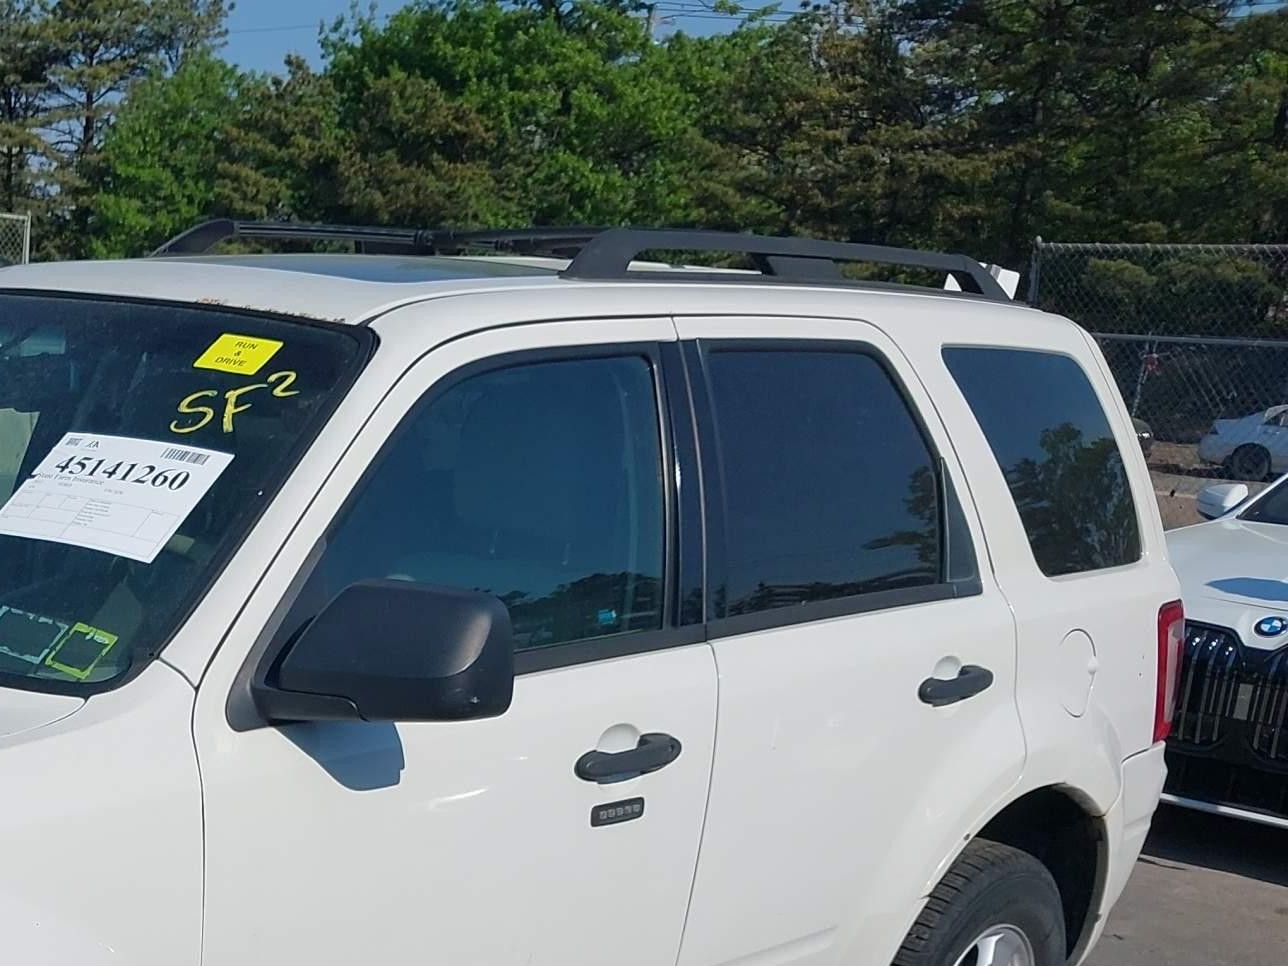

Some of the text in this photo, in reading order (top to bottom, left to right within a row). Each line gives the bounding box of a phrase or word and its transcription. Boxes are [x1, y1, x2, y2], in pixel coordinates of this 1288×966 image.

[235, 341, 258, 350] RUN
[215, 357, 247, 367] DRIVE
[54, 455, 191, 491] 45141260
